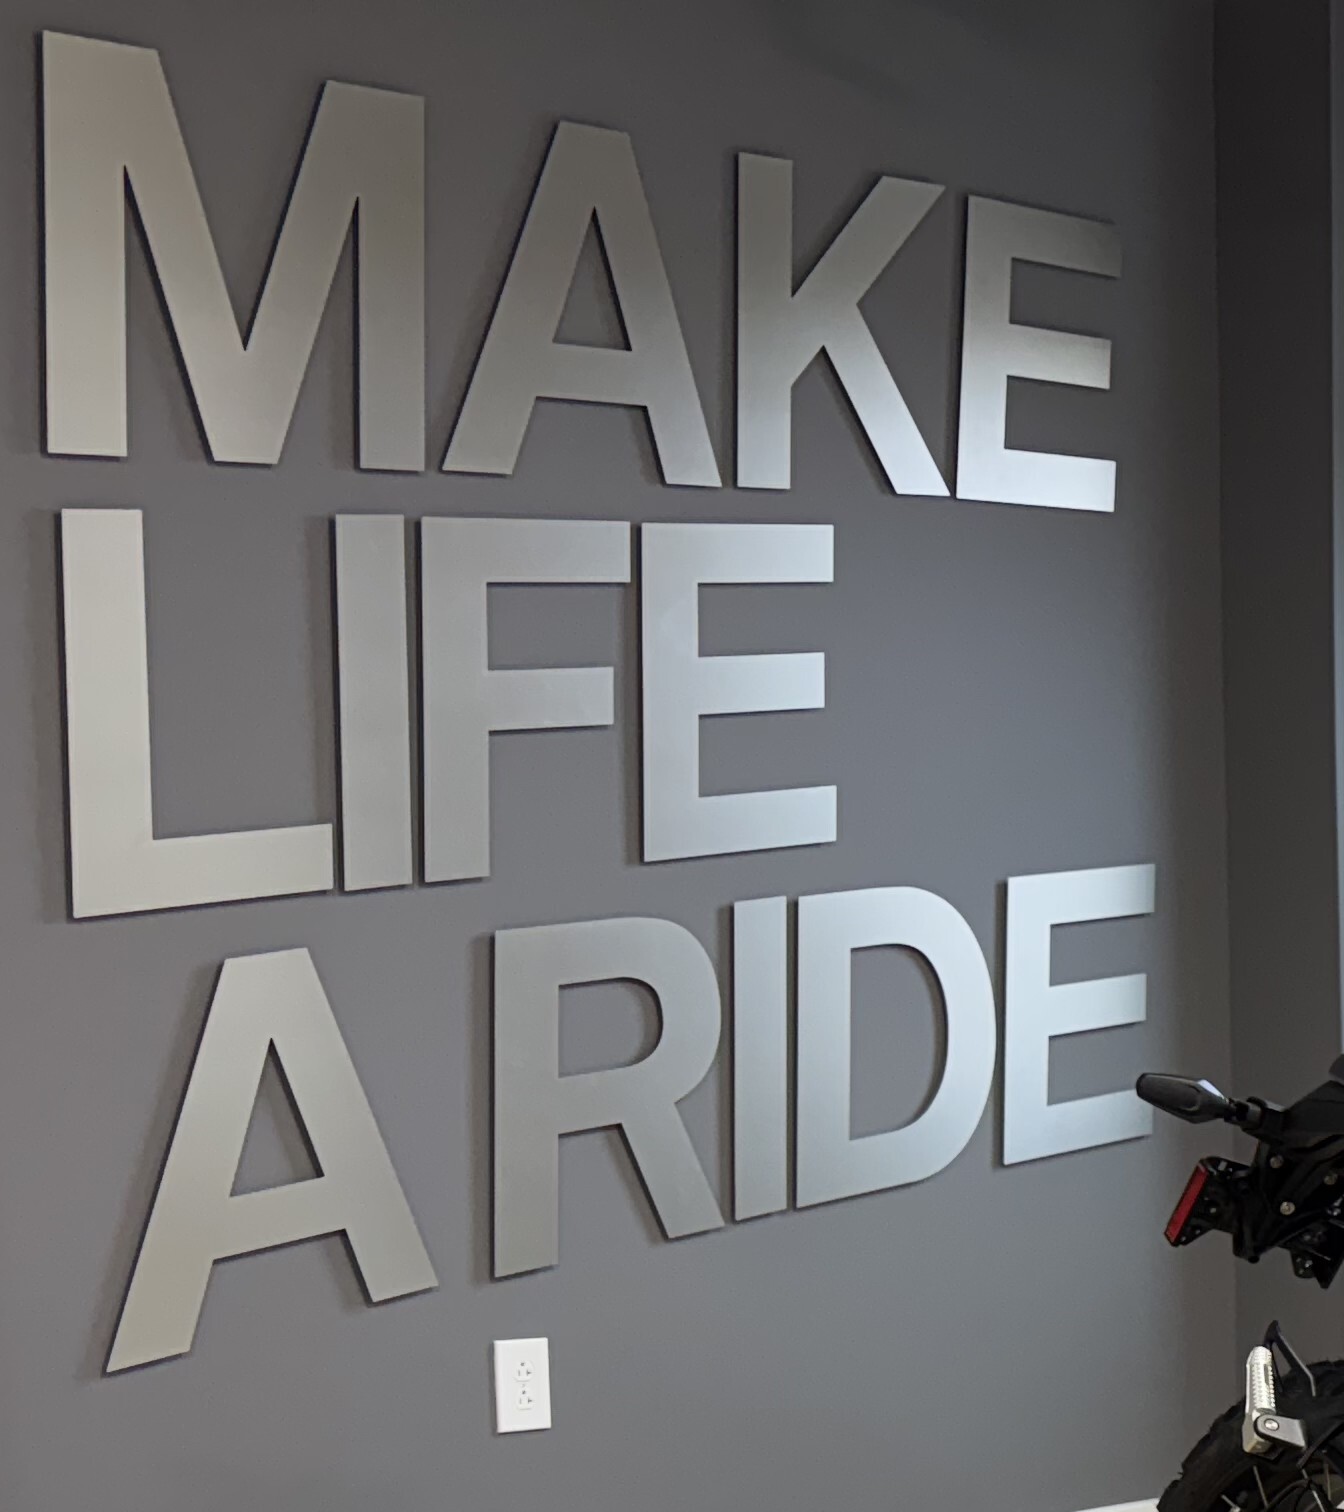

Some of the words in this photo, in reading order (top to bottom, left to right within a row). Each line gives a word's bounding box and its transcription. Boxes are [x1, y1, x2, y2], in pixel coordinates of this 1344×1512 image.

[42, 29, 1123, 512] MAKE
[61, 508, 838, 919] LIFE
[105, 947, 439, 1374] A
[492, 863, 1156, 1278] RIDE
